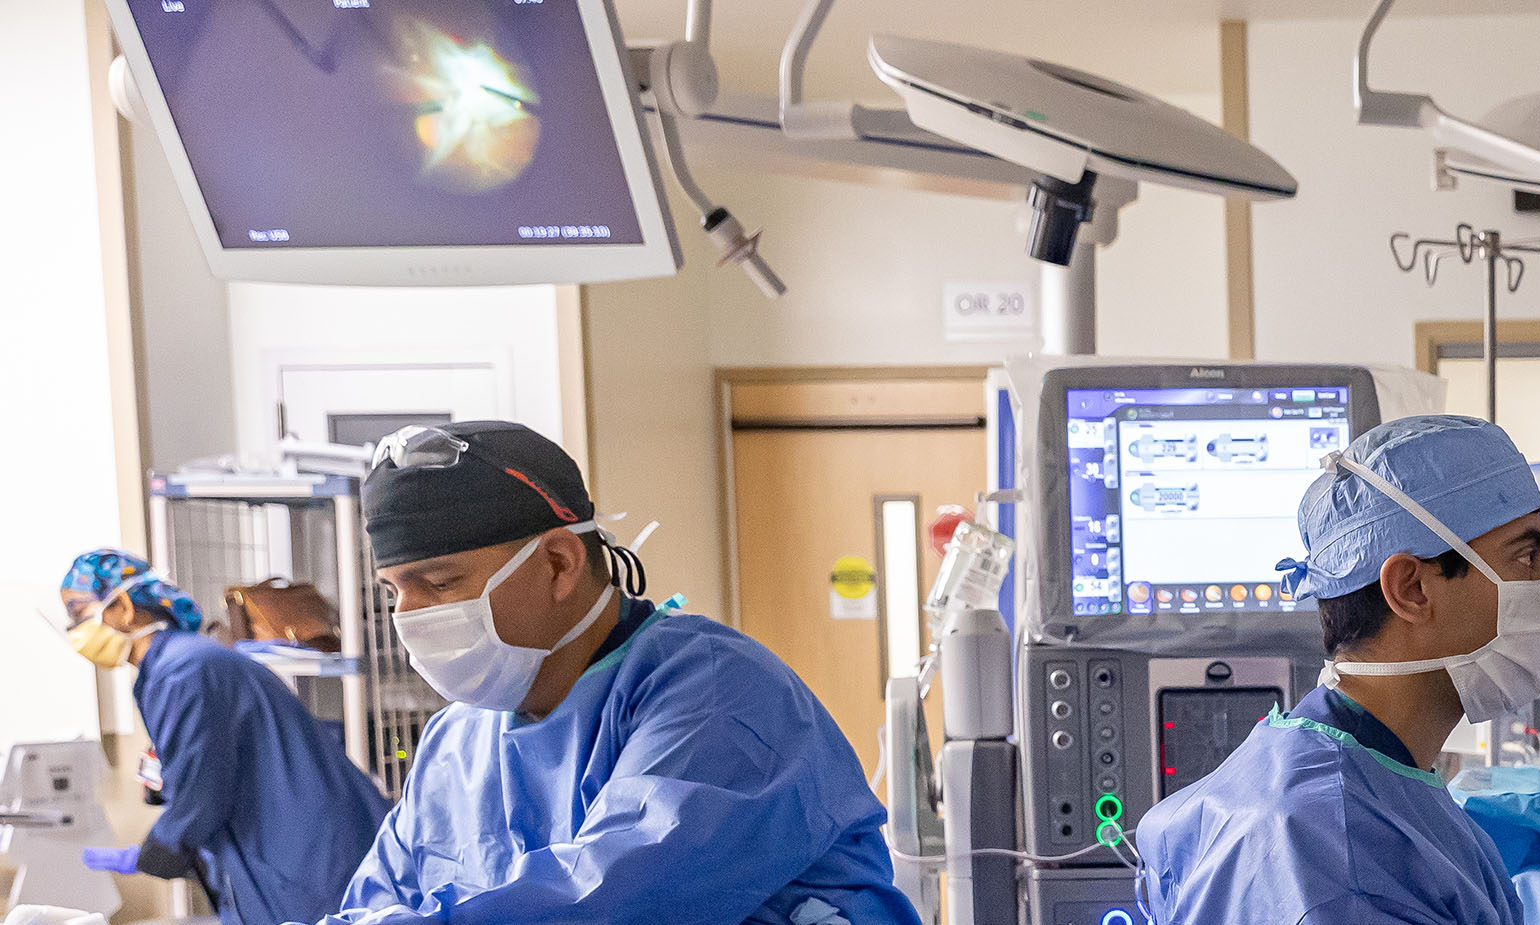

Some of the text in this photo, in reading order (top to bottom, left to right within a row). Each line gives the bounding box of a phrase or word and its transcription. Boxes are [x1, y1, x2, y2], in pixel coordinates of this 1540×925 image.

[954, 292, 1025, 316] OR 20
[1190, 367, 1225, 378] Alcon
